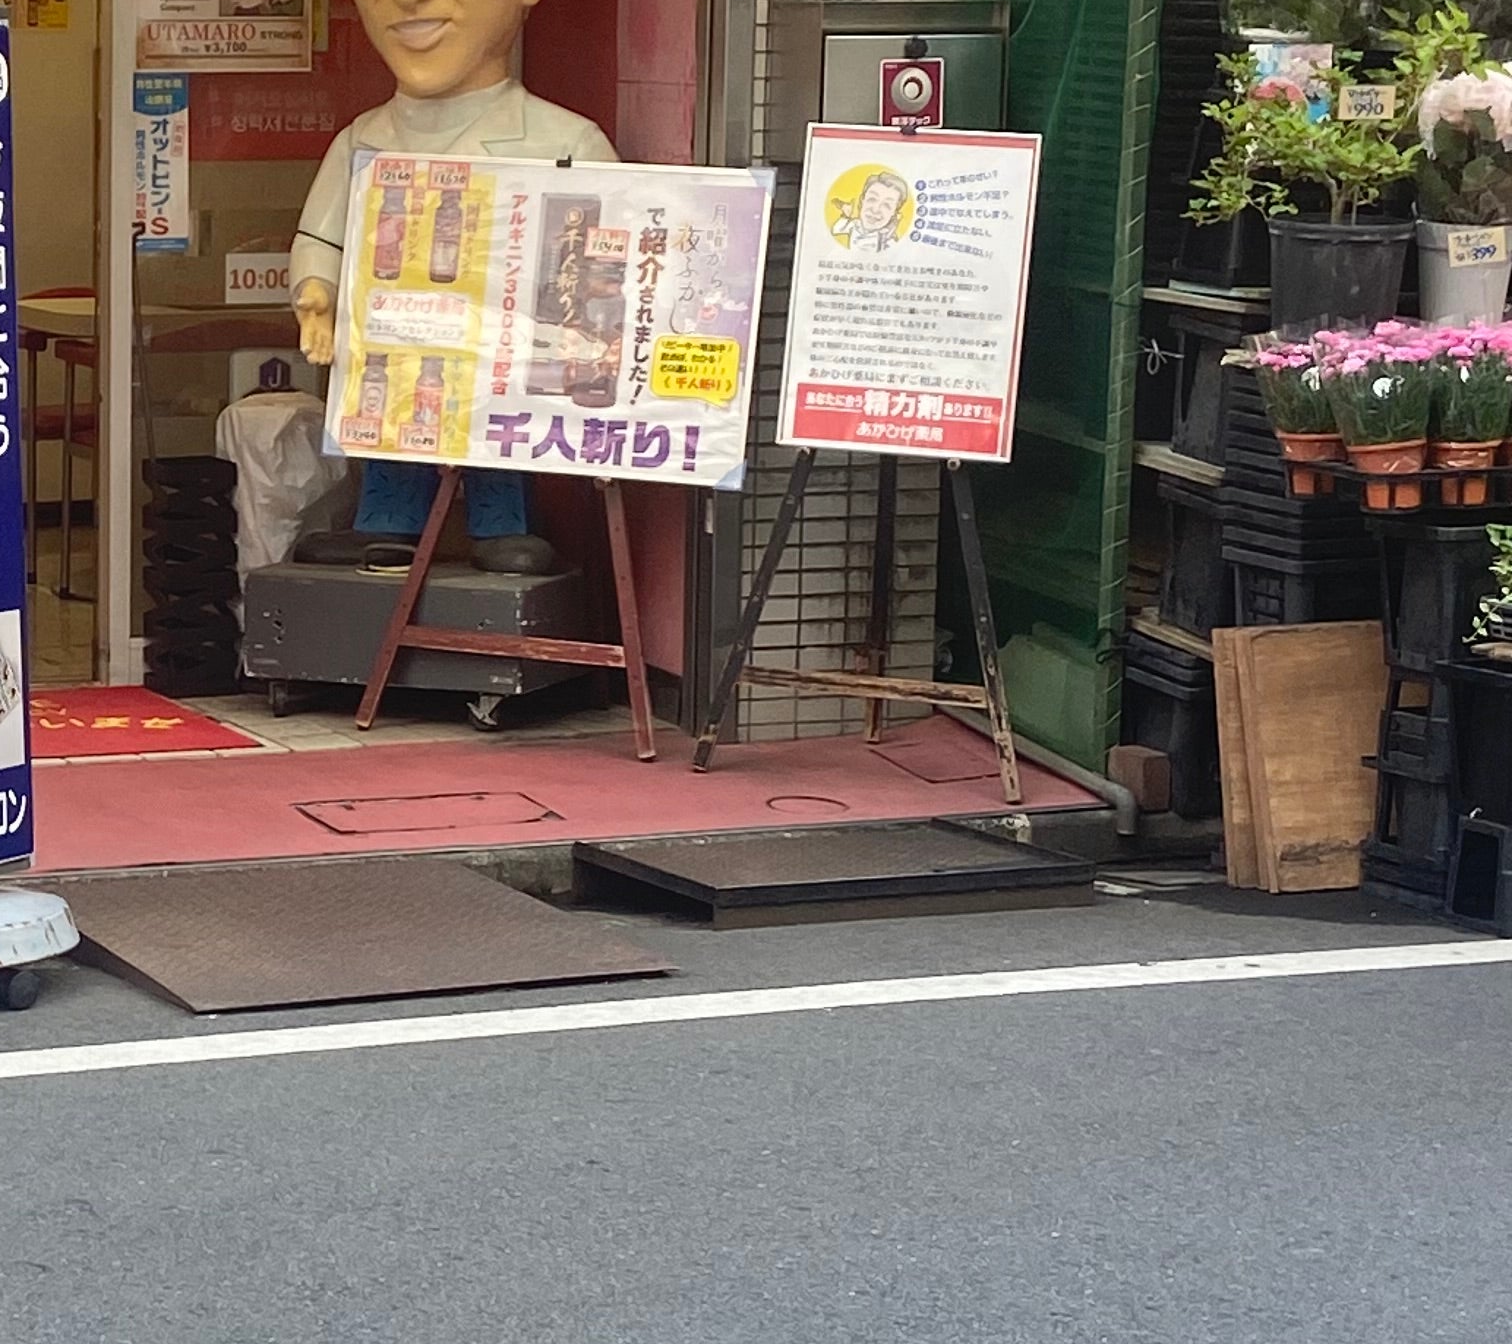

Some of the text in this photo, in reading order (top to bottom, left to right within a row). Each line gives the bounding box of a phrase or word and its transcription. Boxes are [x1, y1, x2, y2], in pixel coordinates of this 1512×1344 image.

[147, 23, 257, 41] UTAMARO
[229, 268, 289, 290] 10:00
[484, 411, 702, 473] 千人斬り!
